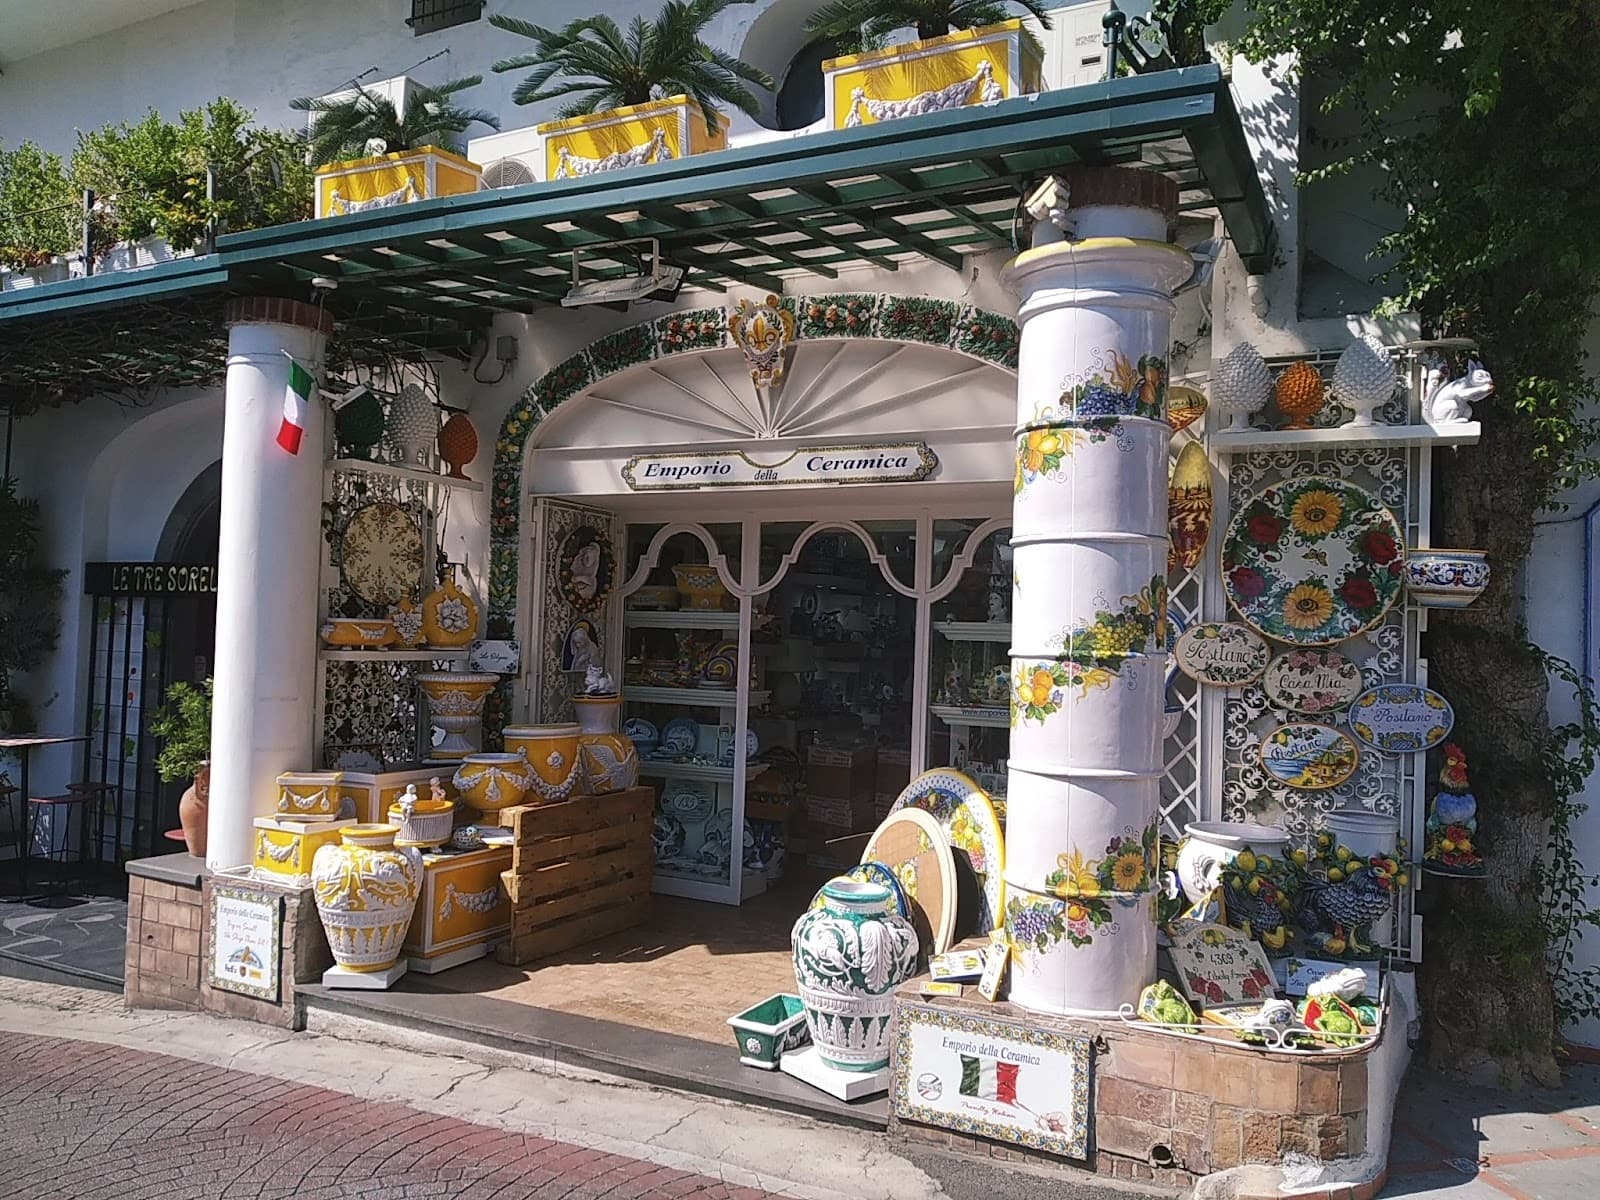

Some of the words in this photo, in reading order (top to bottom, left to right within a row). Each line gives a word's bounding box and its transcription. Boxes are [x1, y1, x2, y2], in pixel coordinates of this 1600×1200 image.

[645, 460, 731, 480] Emporio
[754, 469, 779, 481] della
[806, 453, 908, 472] Ceramica
[112, 566, 129, 591] LE
[133, 566, 163, 592] TRE
[1279, 674, 1312, 688] Casa
[1315, 673, 1343, 689] Mia
[1373, 708, 1433, 722] Positano
[1270, 738, 1322, 762] Positano
[942, 1036, 977, 1054] Emporio
[978, 1044, 999, 1058] della
[1000, 1047, 1041, 1066] Ceramica
